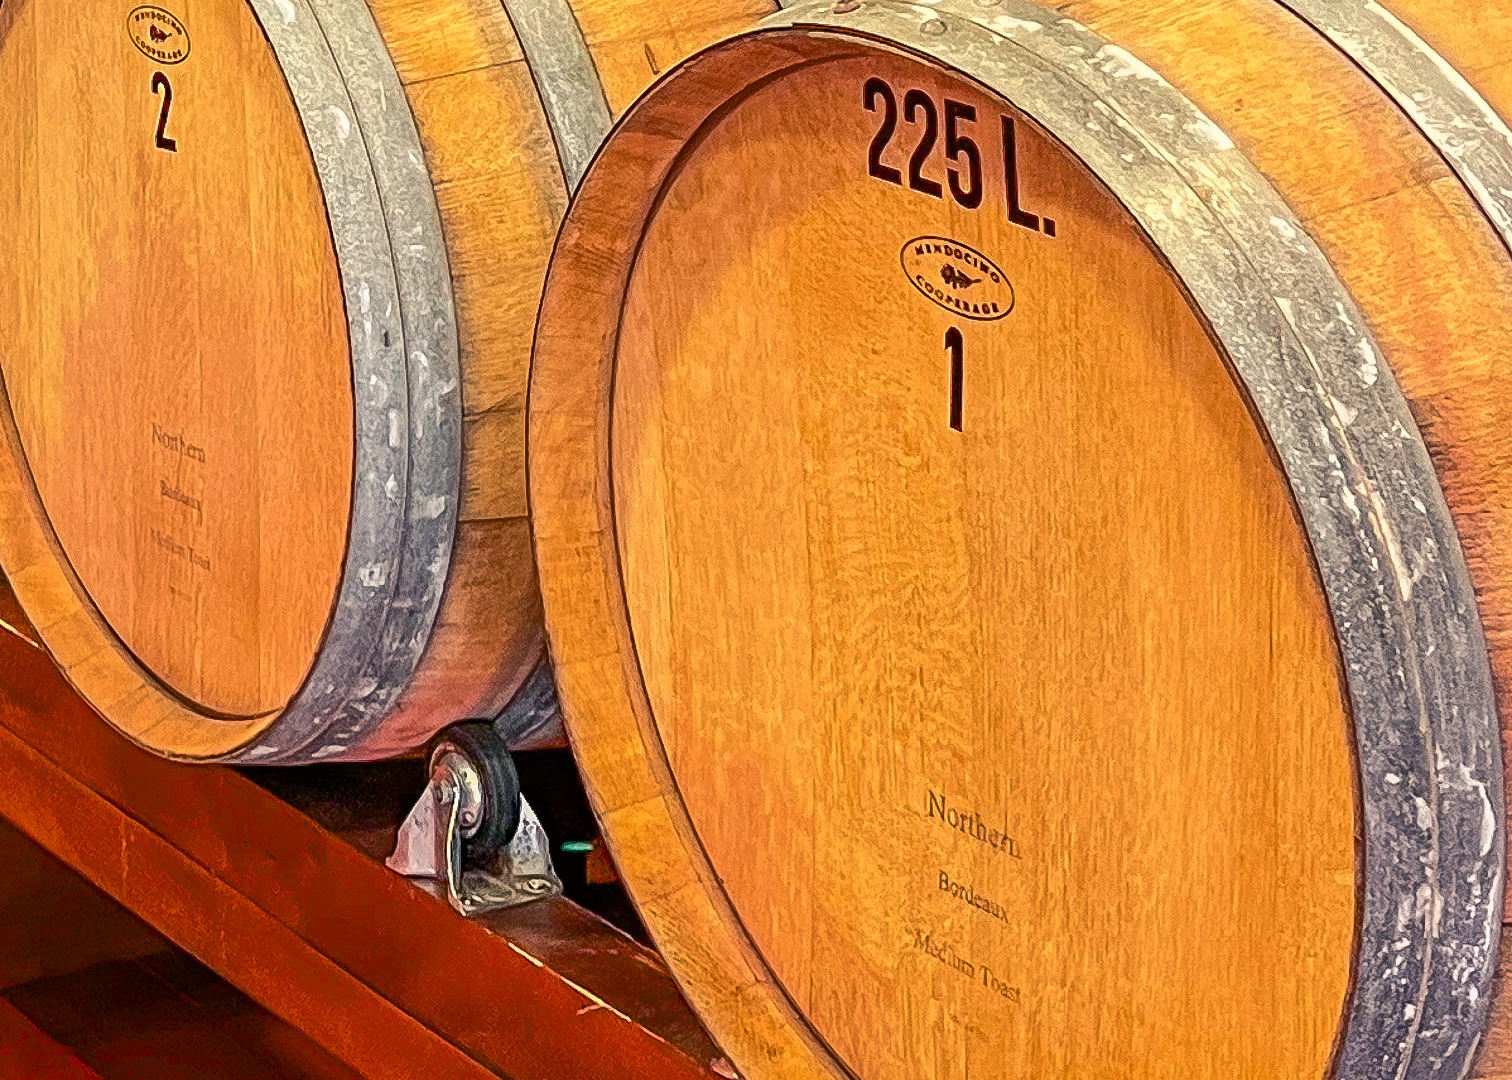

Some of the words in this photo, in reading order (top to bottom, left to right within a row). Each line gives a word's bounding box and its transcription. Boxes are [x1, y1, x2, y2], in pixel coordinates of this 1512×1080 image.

[150, 69, 178, 154] 2
[862, 76, 984, 211] 225
[999, 113, 1057, 239] L.
[943, 324, 965, 434] 1
[926, 788, 1024, 861] Northern
[938, 869, 1010, 925] Bordeaux
